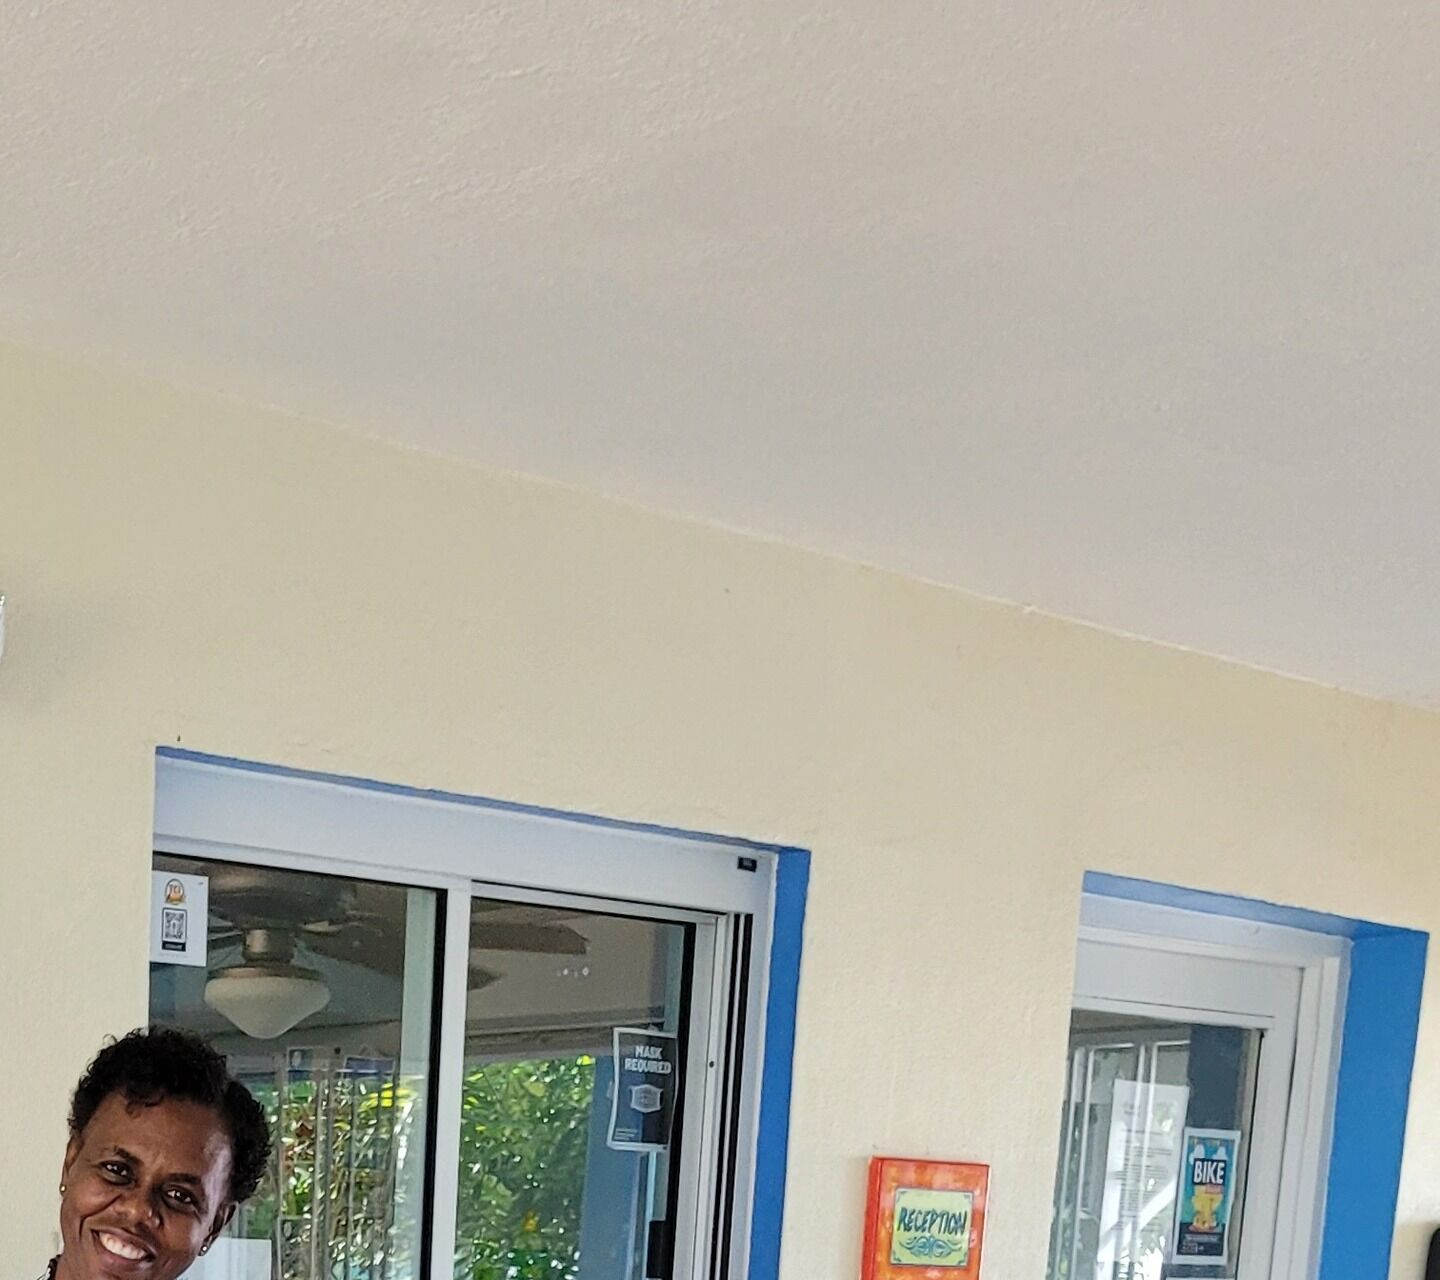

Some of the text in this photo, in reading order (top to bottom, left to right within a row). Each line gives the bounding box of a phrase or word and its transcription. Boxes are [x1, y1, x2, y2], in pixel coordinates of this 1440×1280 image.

[635, 1045, 662, 1059] MASK
[625, 1058, 671, 1074] REQUIRED
[1193, 1160, 1226, 1184] BIKE
[897, 1207, 967, 1235] RECEPTION
